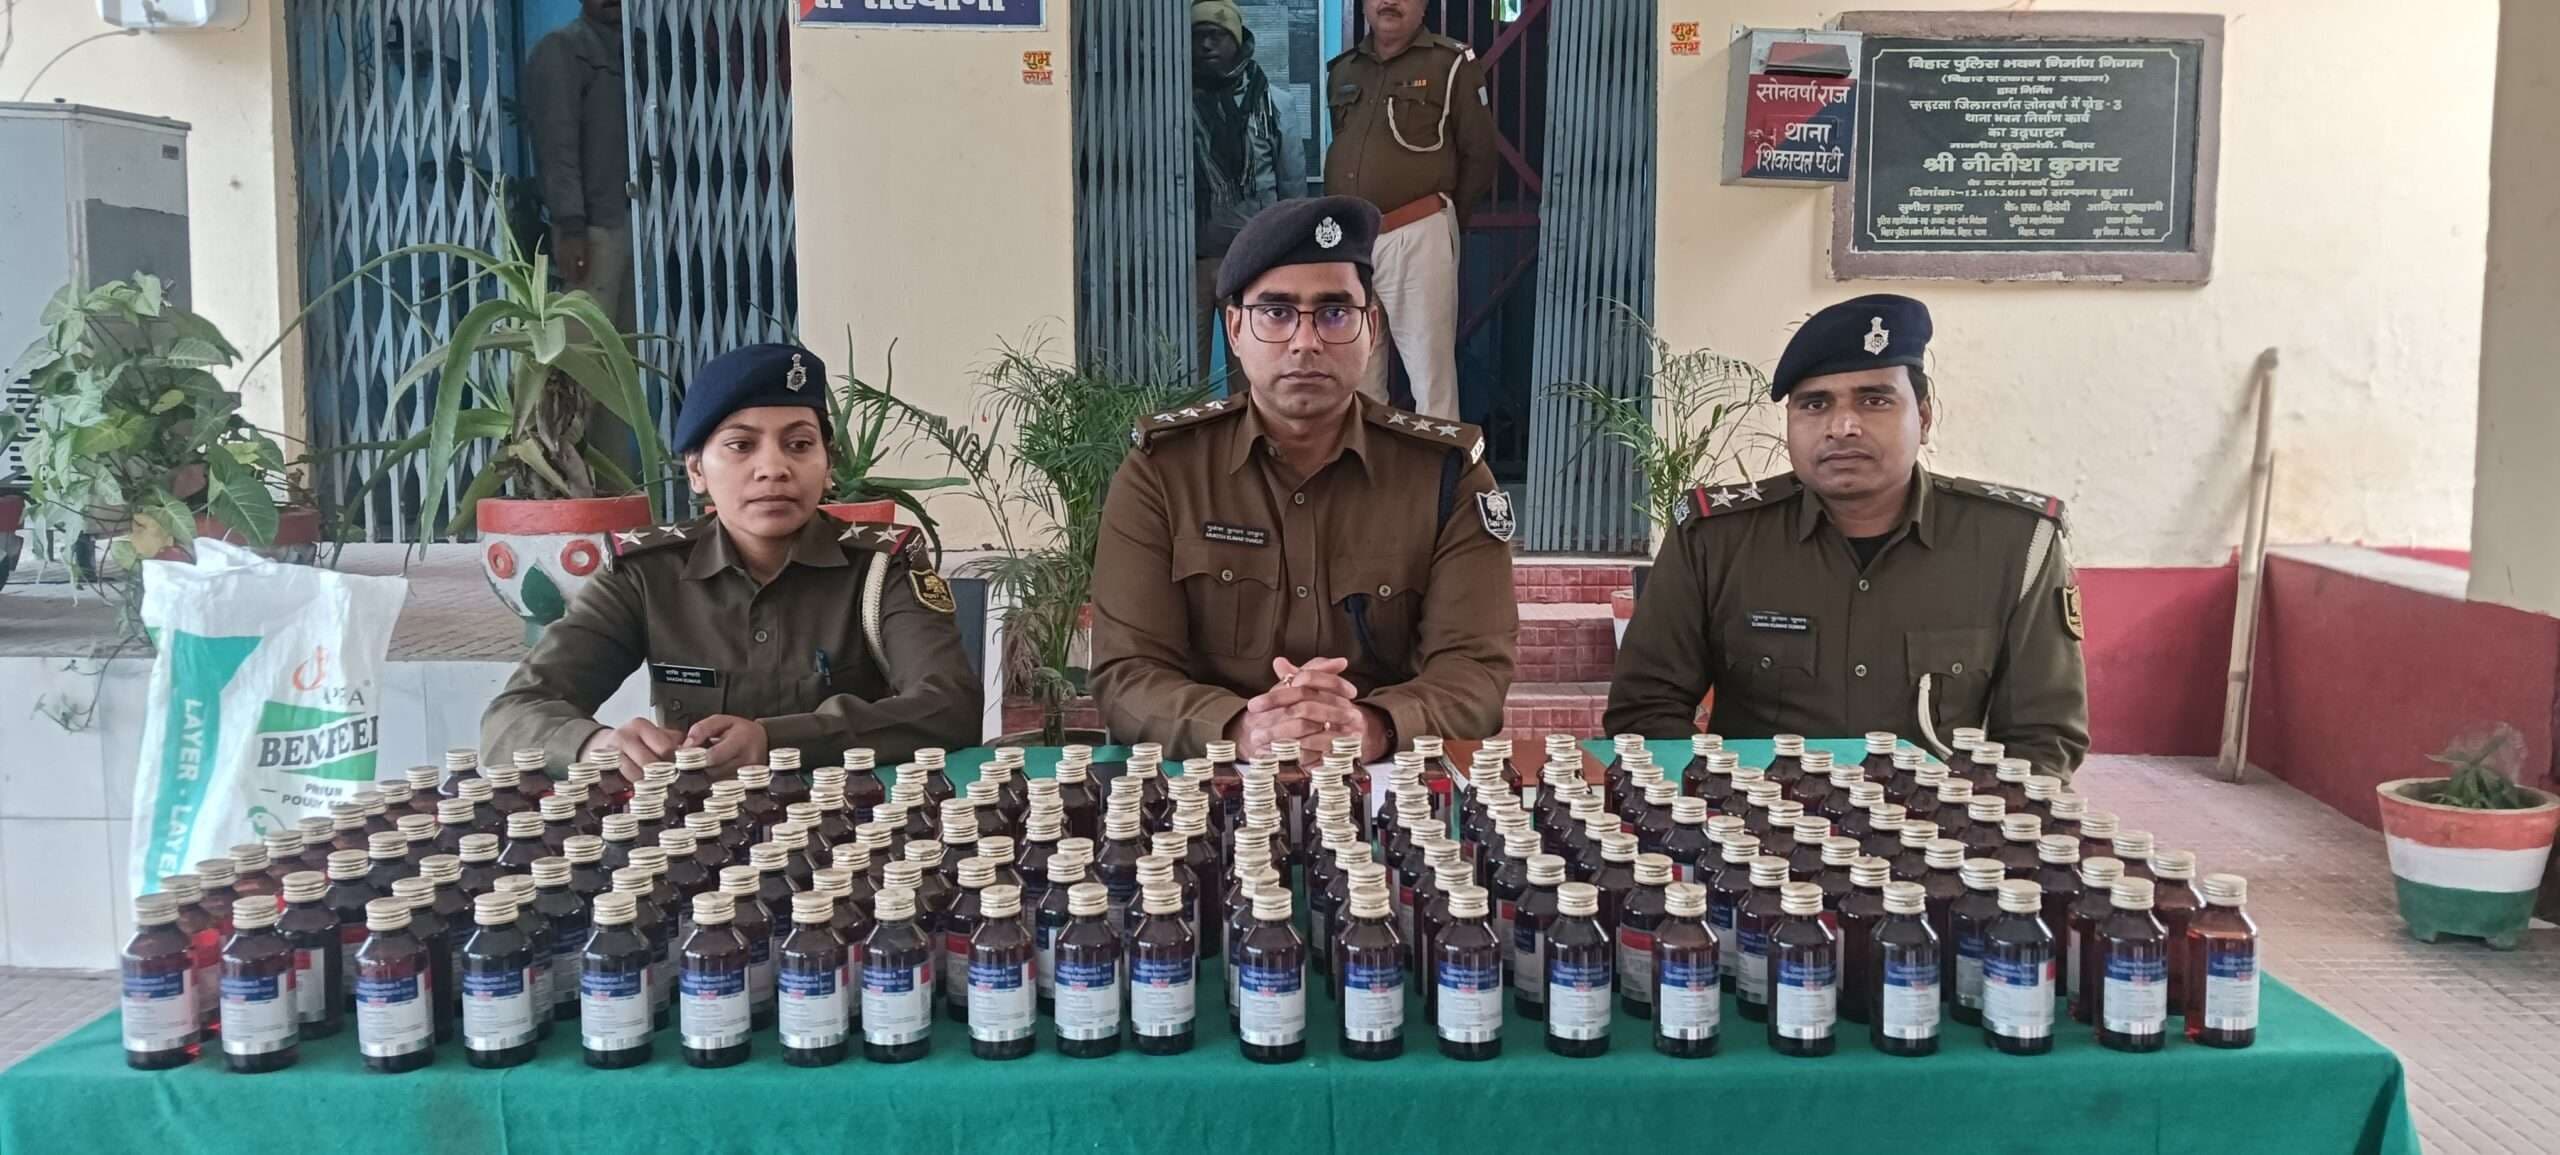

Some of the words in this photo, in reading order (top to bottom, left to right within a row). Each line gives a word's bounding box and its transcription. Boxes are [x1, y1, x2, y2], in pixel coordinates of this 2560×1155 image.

[1908, 56, 1951, 70] बिहार
[1953, 56, 2000, 73] पुलिस
[2044, 55, 2096, 69] निर्माण
[2098, 55, 2144, 69] निगम
[1818, 85, 1850, 106] राज
[1965, 113, 1992, 122] थाना
[1785, 122, 1832, 144] थाना
[1988, 127, 2007, 137] का
[1816, 145, 1844, 174] पेटी
[1922, 151, 1956, 173] श्री
[1961, 151, 2043, 174] नीतीश
[2047, 157, 2122, 178] कुमार
[176, 699, 203, 781] LAYER
